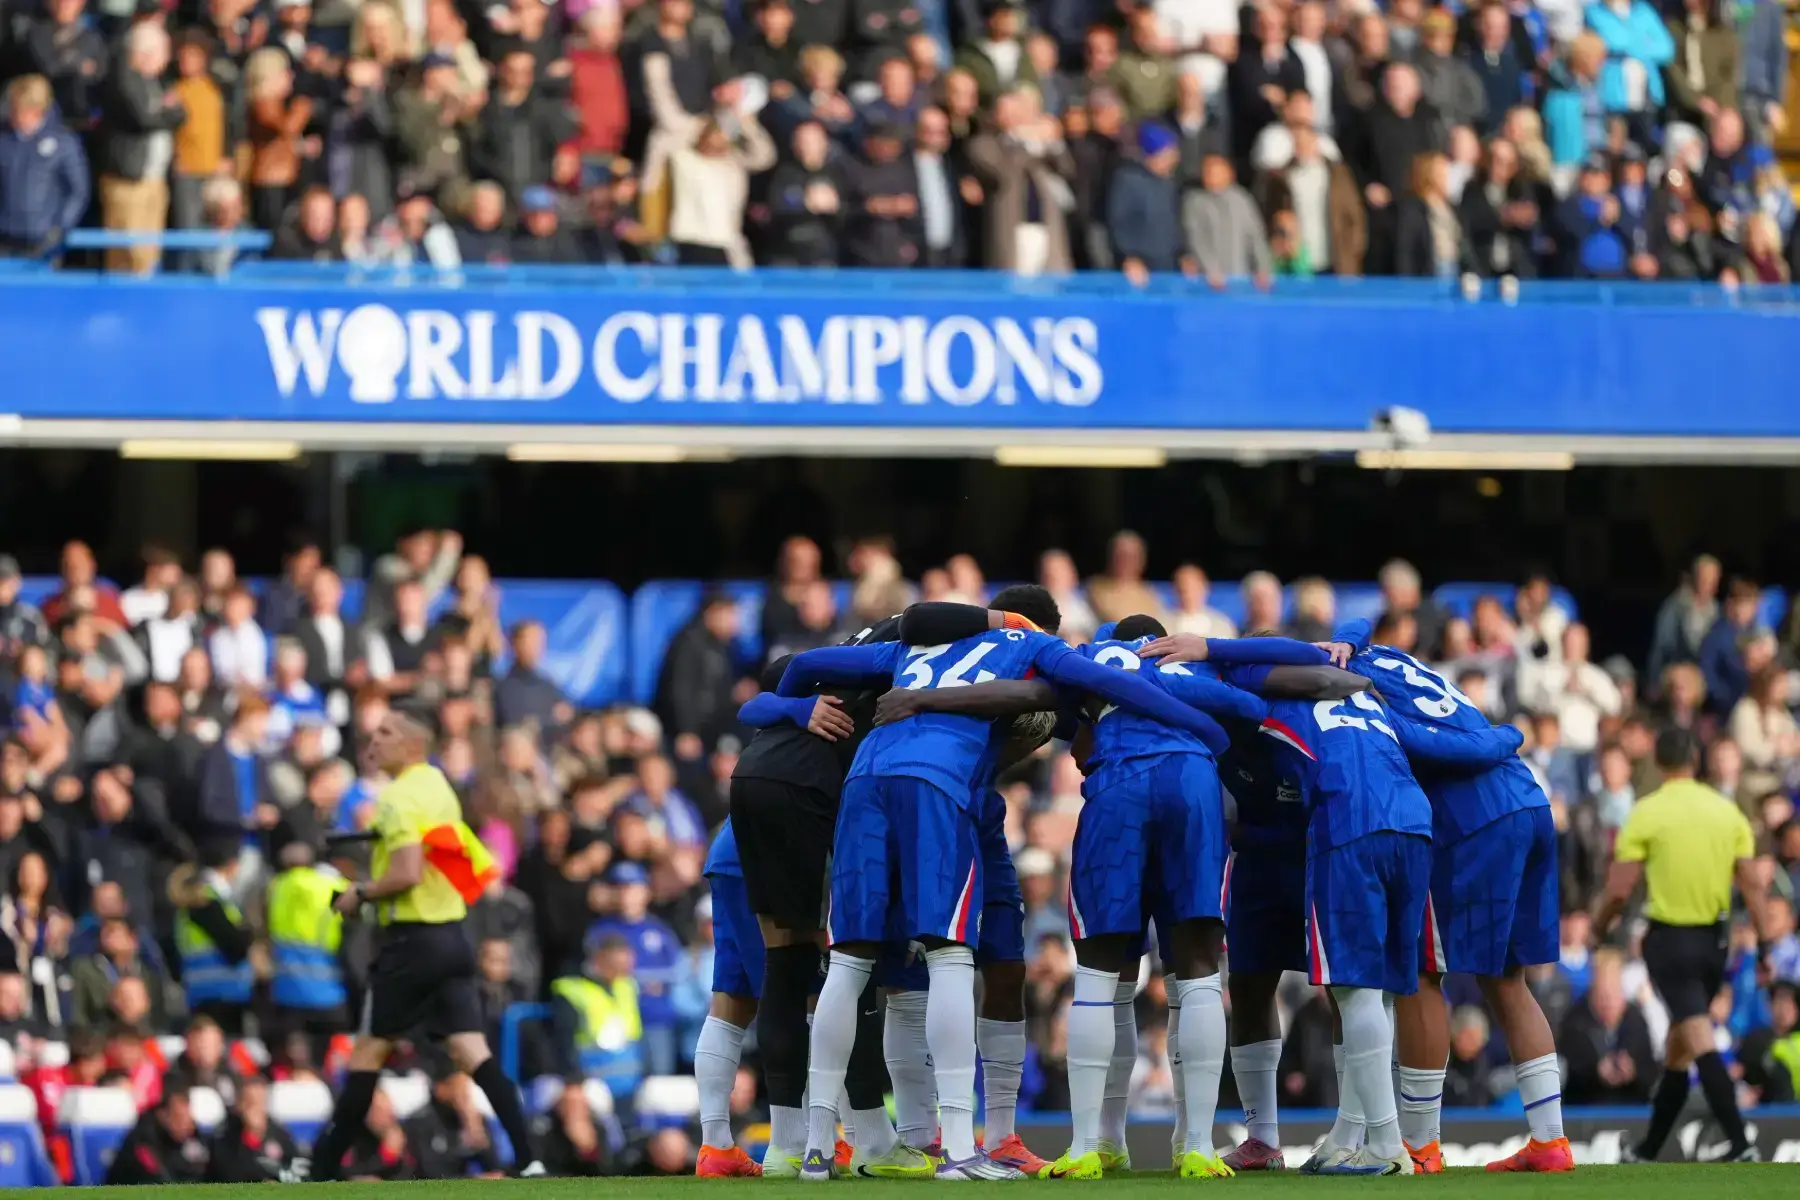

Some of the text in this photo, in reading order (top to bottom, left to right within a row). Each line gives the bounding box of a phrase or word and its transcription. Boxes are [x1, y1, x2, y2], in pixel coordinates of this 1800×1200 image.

[255, 303, 1103, 406] WORLD CHAMPIONS
[901, 641, 998, 690] 34
